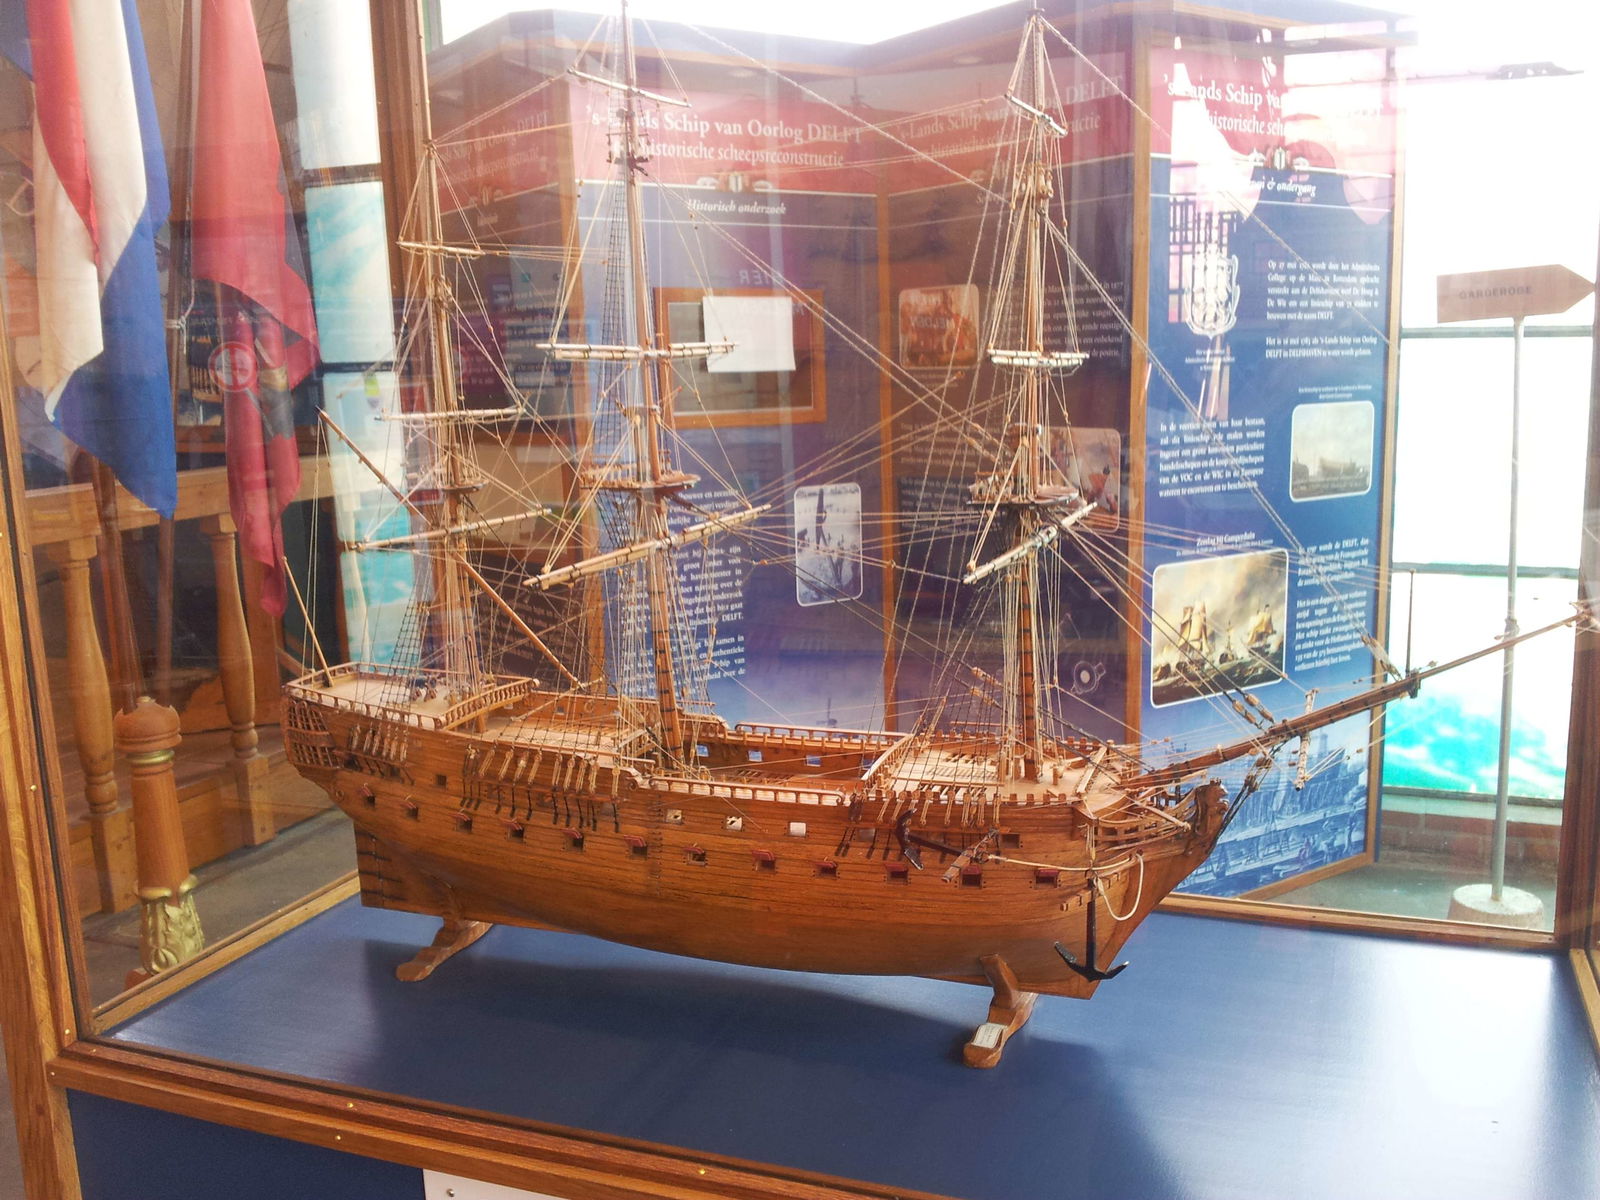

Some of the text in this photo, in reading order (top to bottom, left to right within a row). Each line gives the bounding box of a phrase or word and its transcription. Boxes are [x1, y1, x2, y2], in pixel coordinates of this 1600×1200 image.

[1226, 83, 1263, 111] Schip
[663, 111, 710, 138] Schip
[714, 121, 743, 136] van
[747, 119, 803, 145] Oorlog
[807, 123, 861, 144] DELFT
[640, 139, 714, 161] historische
[717, 143, 844, 168] scheepsreconstructie
[1266, 176, 1276, 190] &
[1277, 178, 1316, 197] ondergang
[687, 199, 787, 215] Historisch onderzoek
[722, 612, 744, 622] DELFT.
